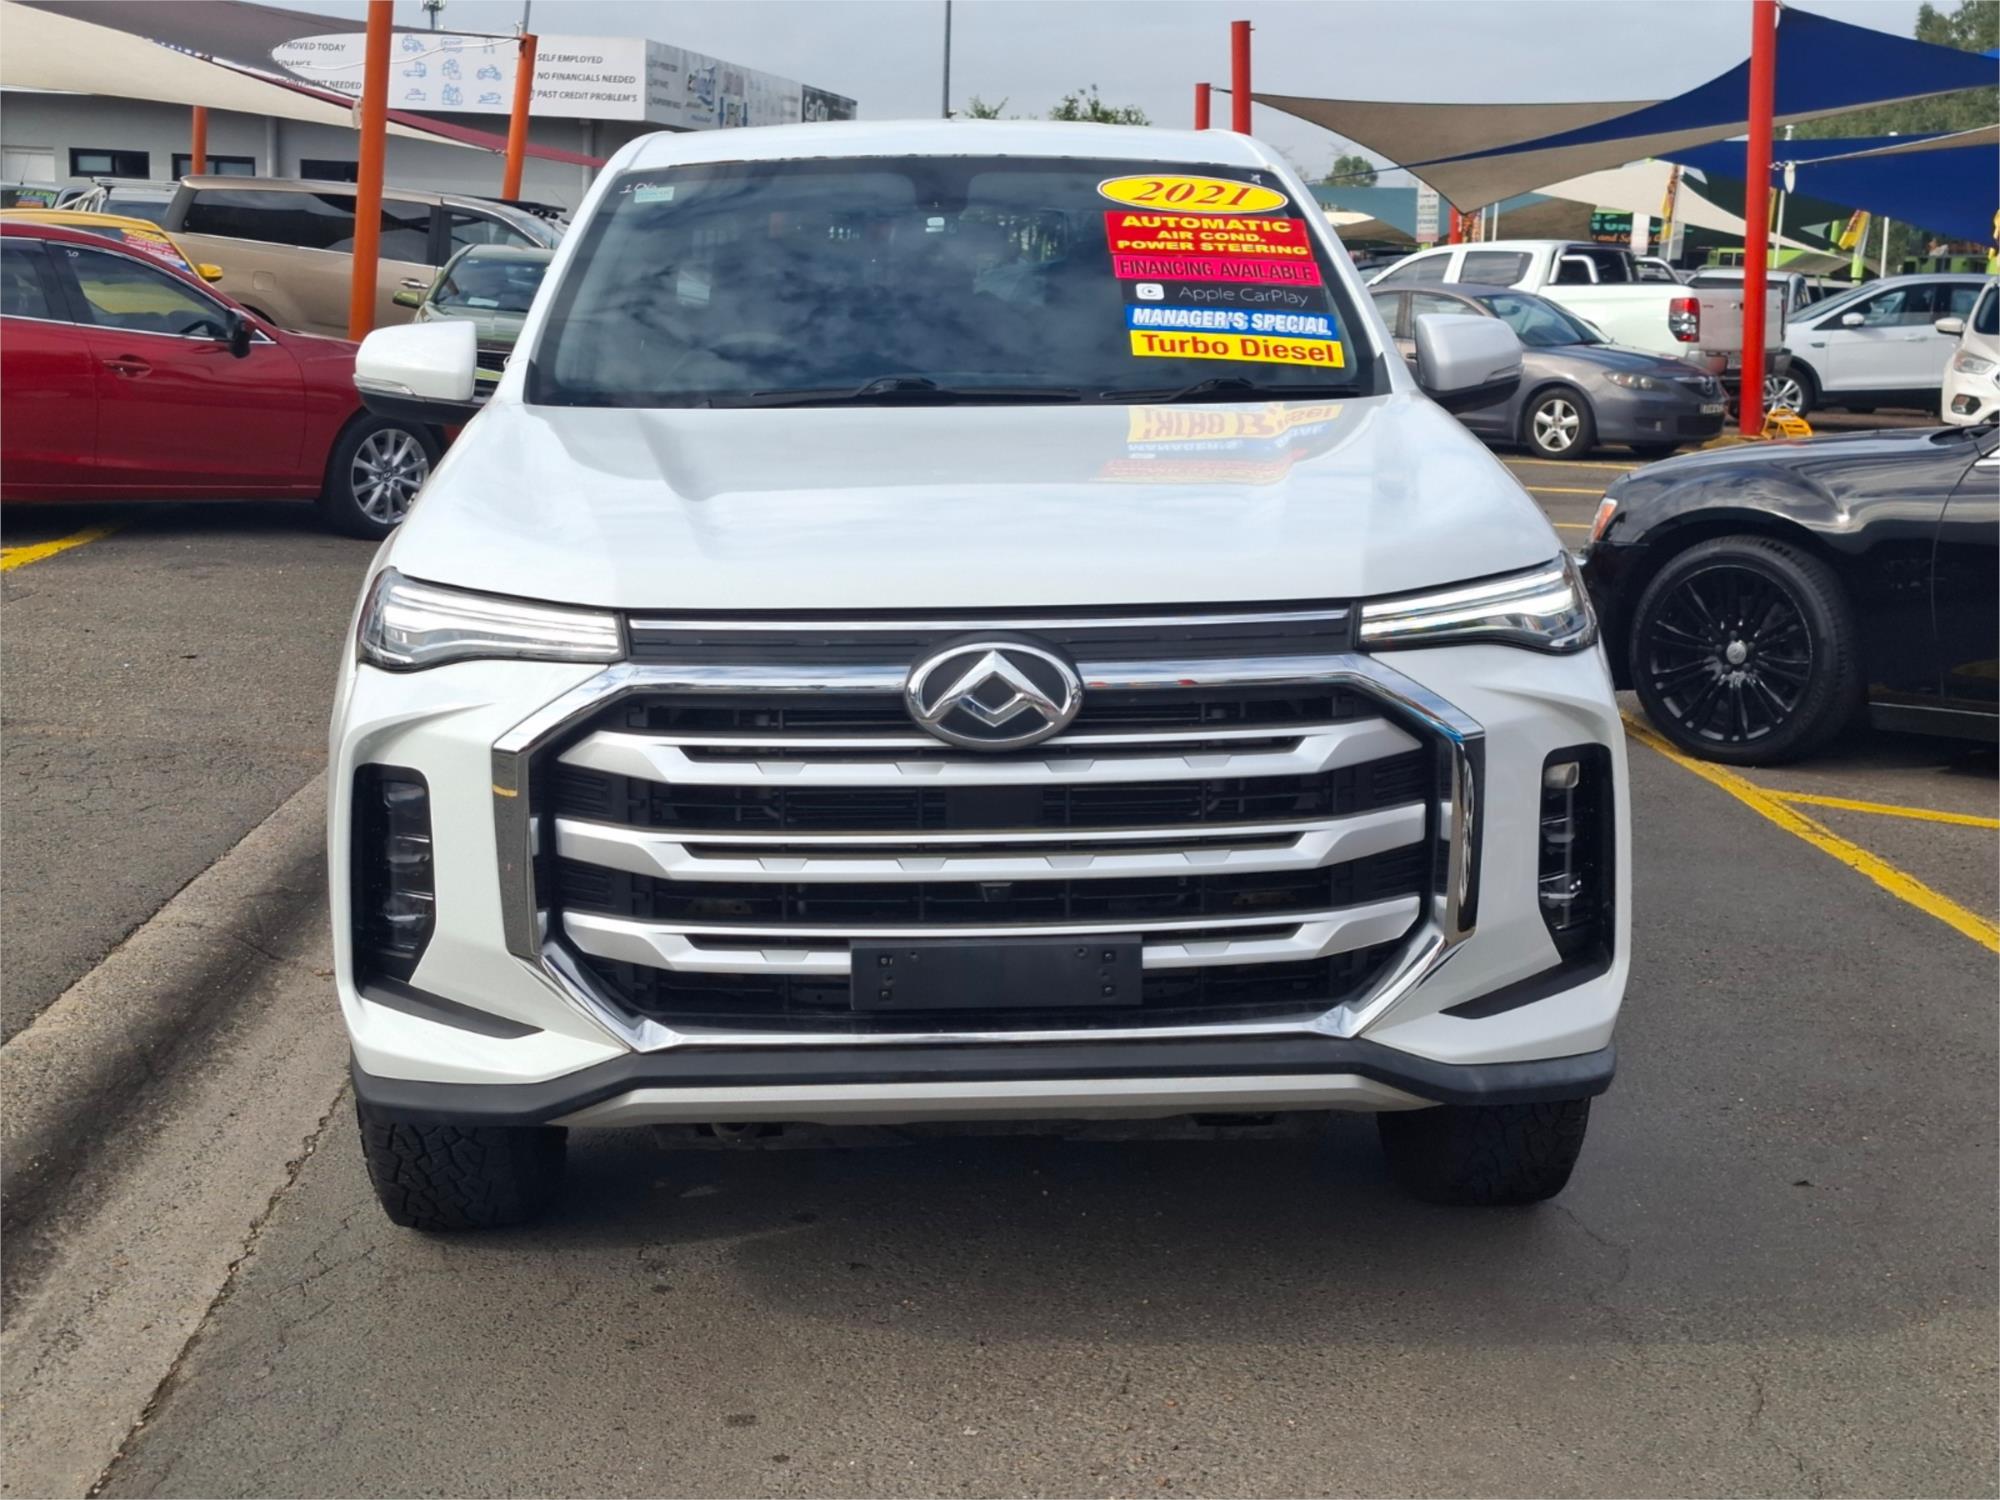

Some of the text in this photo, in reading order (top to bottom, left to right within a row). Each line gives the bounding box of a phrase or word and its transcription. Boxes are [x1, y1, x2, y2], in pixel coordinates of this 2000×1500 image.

[317, 43, 346, 51] TODAY
[537, 53, 604, 64] SELF EMPLOYED
[330, 80, 362, 89] NEEDED
[537, 72, 636, 84] NO FINANCIALS NEEDED
[537, 90, 638, 102] PAST CREDIT PROBLEM'S
[1131, 181, 1252, 206] 2021
[1121, 215, 1291, 233] AUTOMATIC
[1157, 230, 1266, 243] AIR COND.
[1117, 240, 1308, 256] POWER STEERING
[1120, 261, 1313, 281] FINANCING AVAILABLE
[1178, 286, 1309, 307] Apple CarPlay
[1132, 308, 1332, 336] MANAGER'S SPECIAL
[1140, 334, 1334, 362] Turbo Diesel
